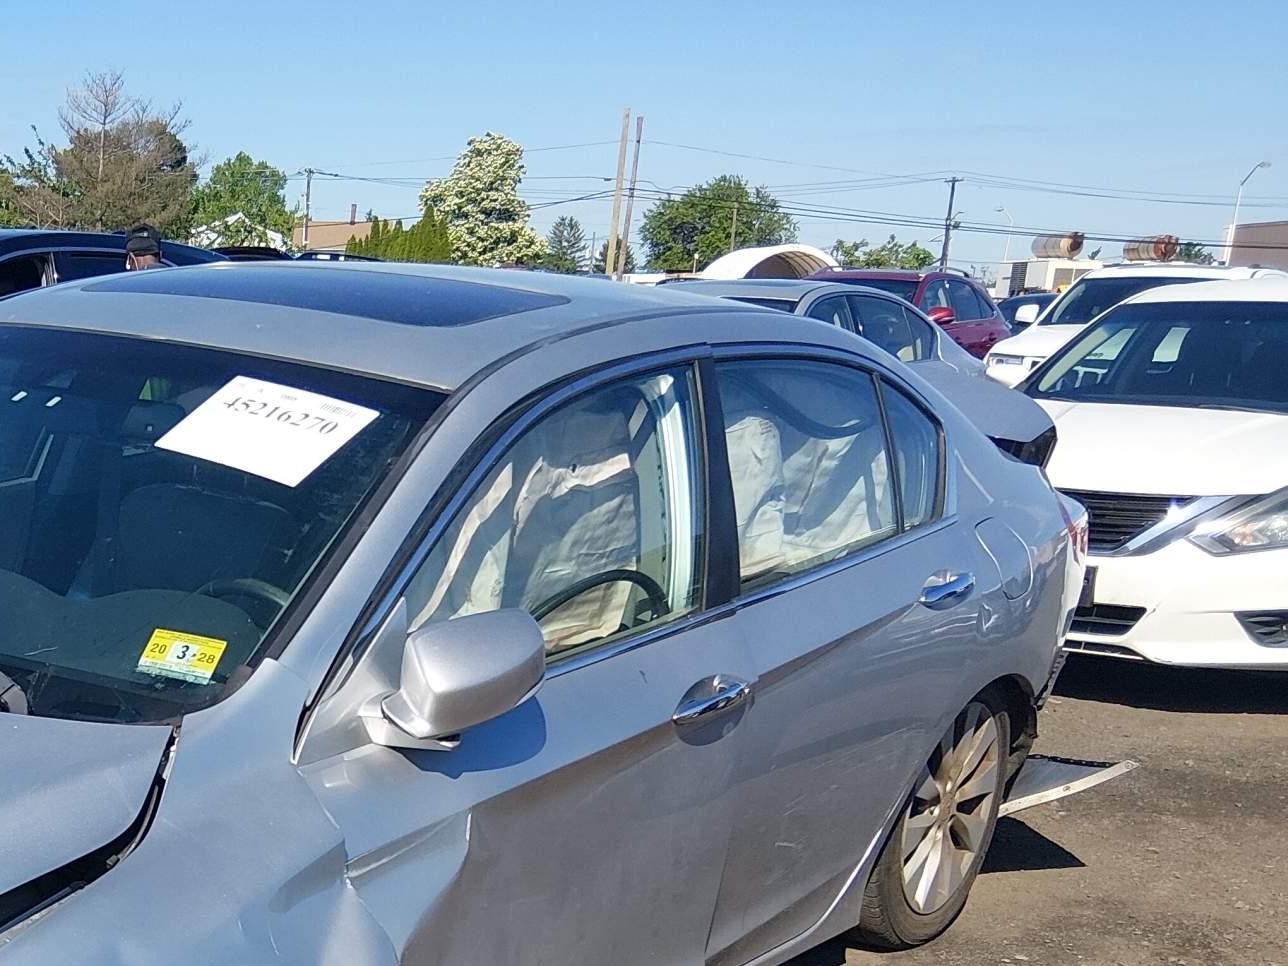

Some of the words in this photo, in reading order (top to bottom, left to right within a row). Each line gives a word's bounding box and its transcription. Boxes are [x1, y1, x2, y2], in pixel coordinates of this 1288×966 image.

[223, 396, 339, 434] 45216270
[150, 642, 168, 655] 20
[176, 644, 190, 660] 3
[196, 652, 216, 664] 28
